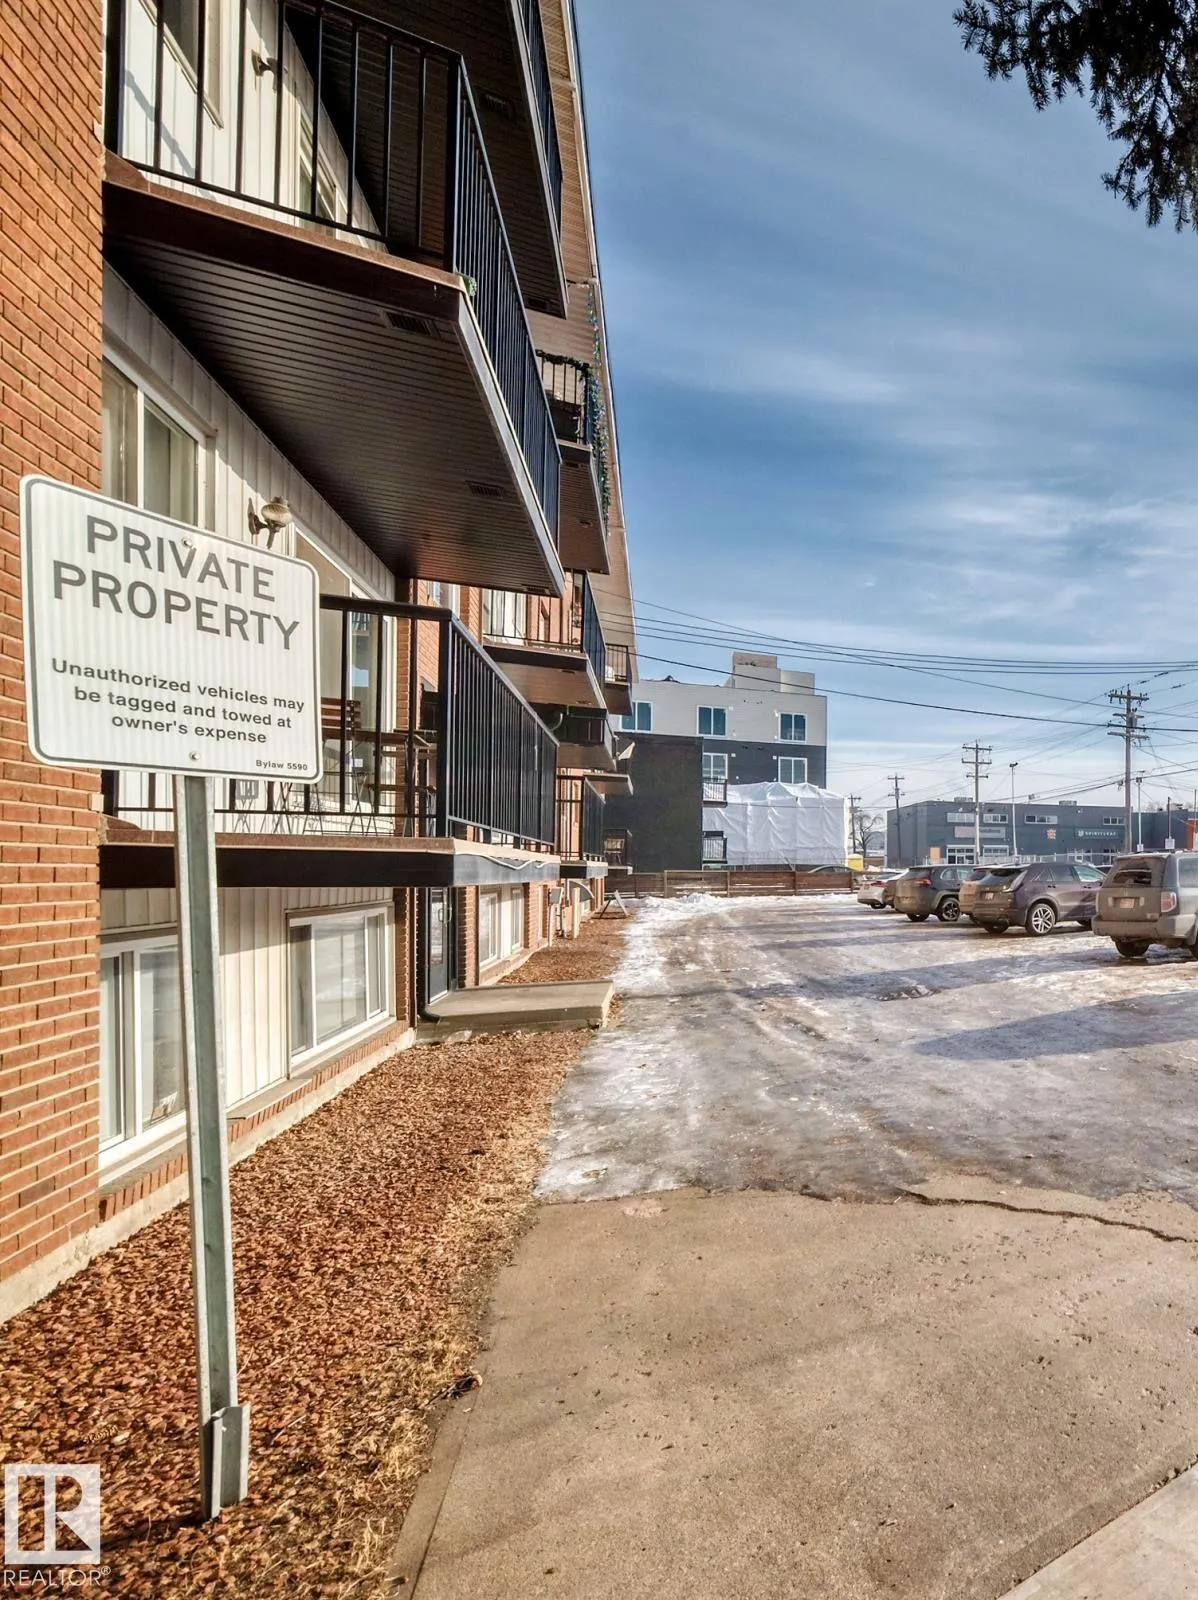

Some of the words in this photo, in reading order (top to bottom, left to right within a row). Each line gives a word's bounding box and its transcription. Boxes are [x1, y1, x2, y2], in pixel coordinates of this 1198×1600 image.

[86, 515, 276, 602] PRIVATE
[53, 560, 300, 650] PROPERTY
[51, 657, 191, 693] Unauthorized
[197, 684, 268, 705] vehicles
[273, 697, 305, 713] may
[74, 686, 101, 702] be
[108, 690, 176, 713] tagged
[183, 704, 216, 718] and
[222, 708, 272, 726] towed
[277, 716, 292, 728] at
[111, 715, 188, 735] owner's
[194, 725, 267, 743] expense
[255, 760, 284, 769] Bylaw
